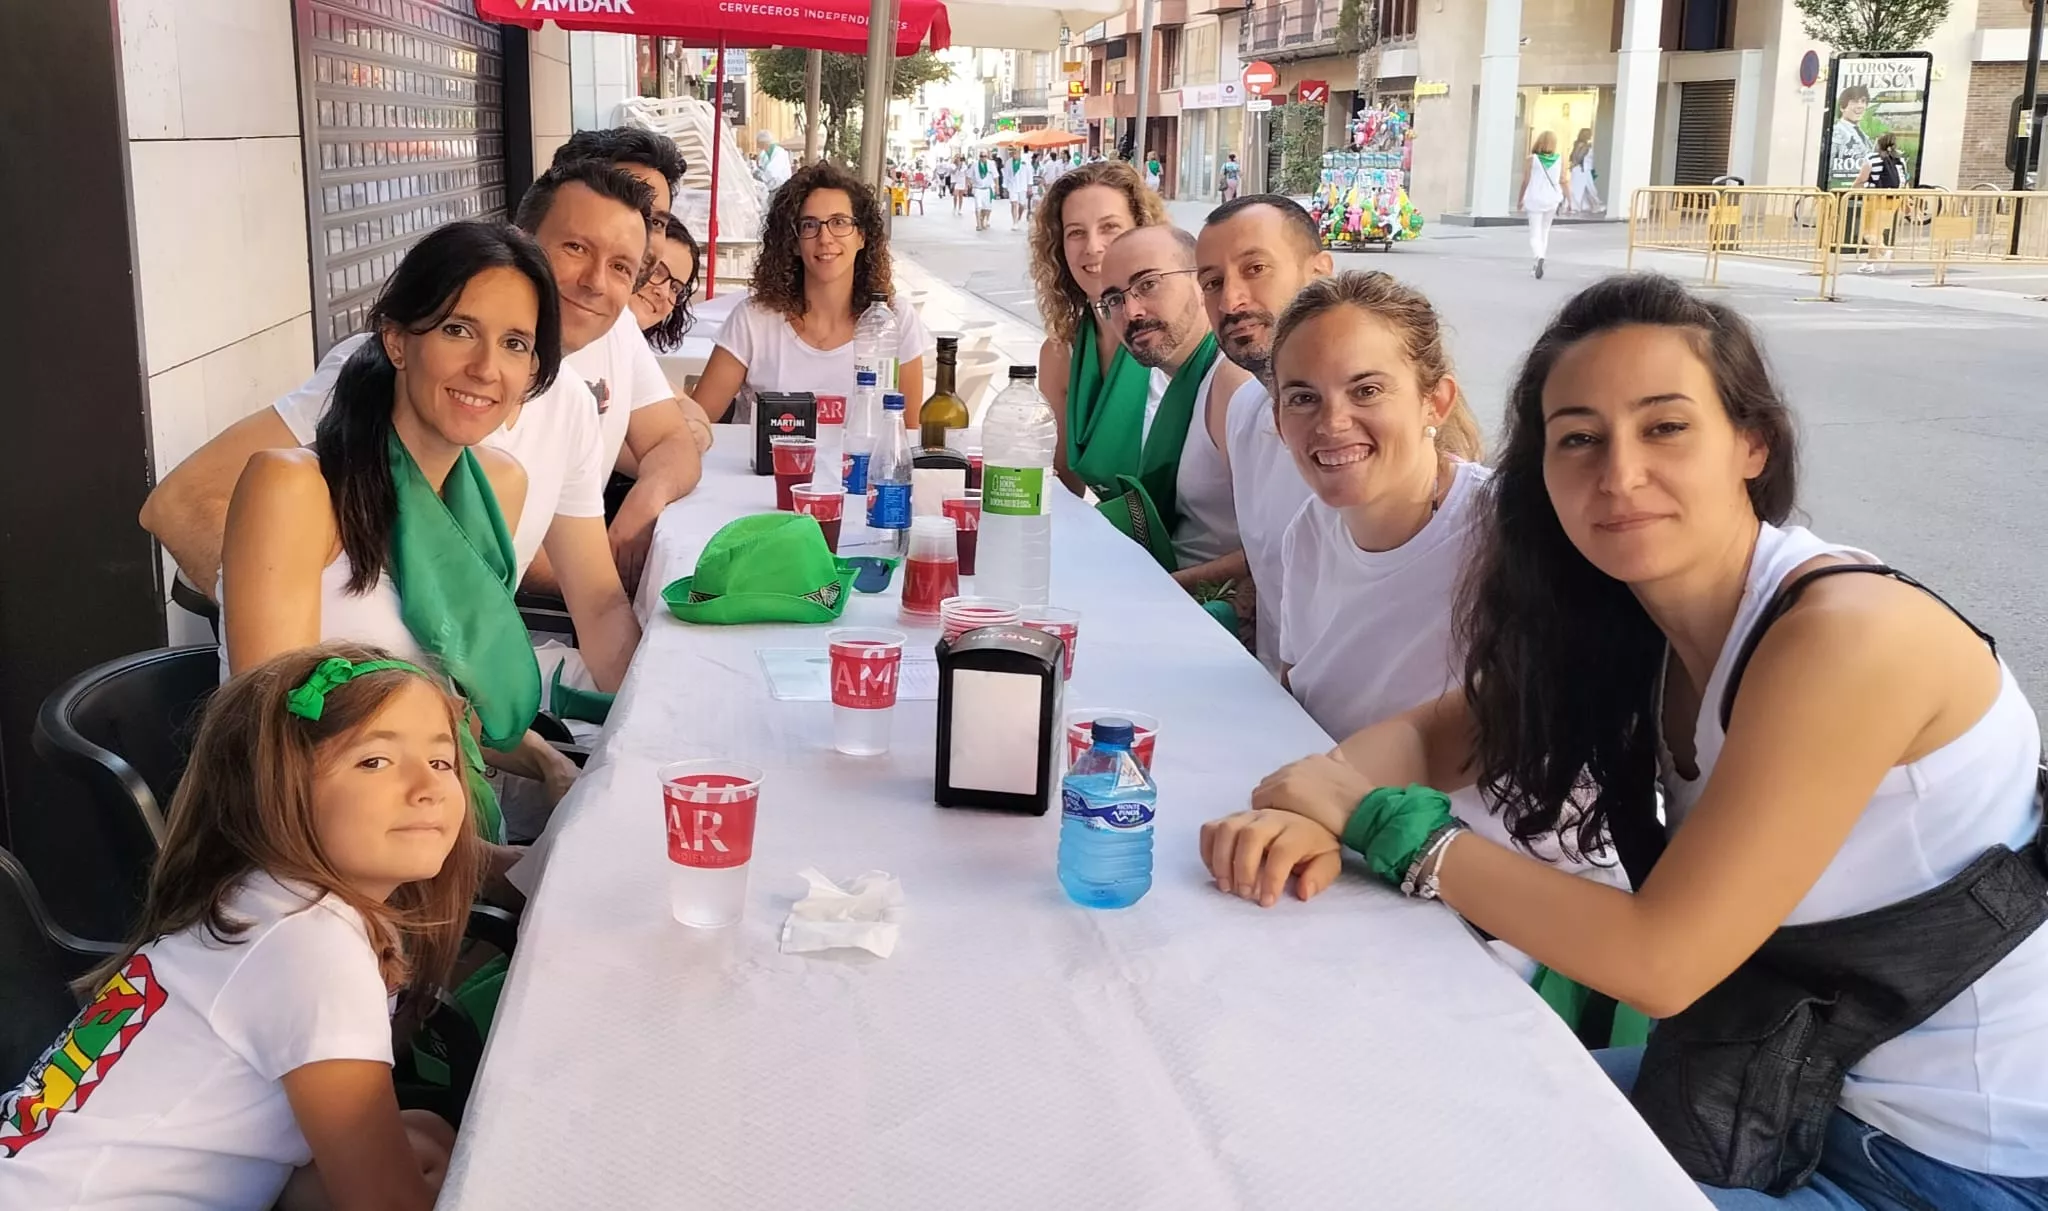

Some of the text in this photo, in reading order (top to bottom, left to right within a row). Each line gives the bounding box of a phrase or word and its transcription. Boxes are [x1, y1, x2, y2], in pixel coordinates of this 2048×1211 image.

[719, 2, 908, 30] CERVECEROS INDEPENDIES
[1848, 62, 1896, 74] TOROS
[1842, 74, 1915, 89] HUESCA
[1832, 157, 1865, 172] ROC
[770, 419, 805, 427] MARTINI
[667, 804, 730, 852] AR
